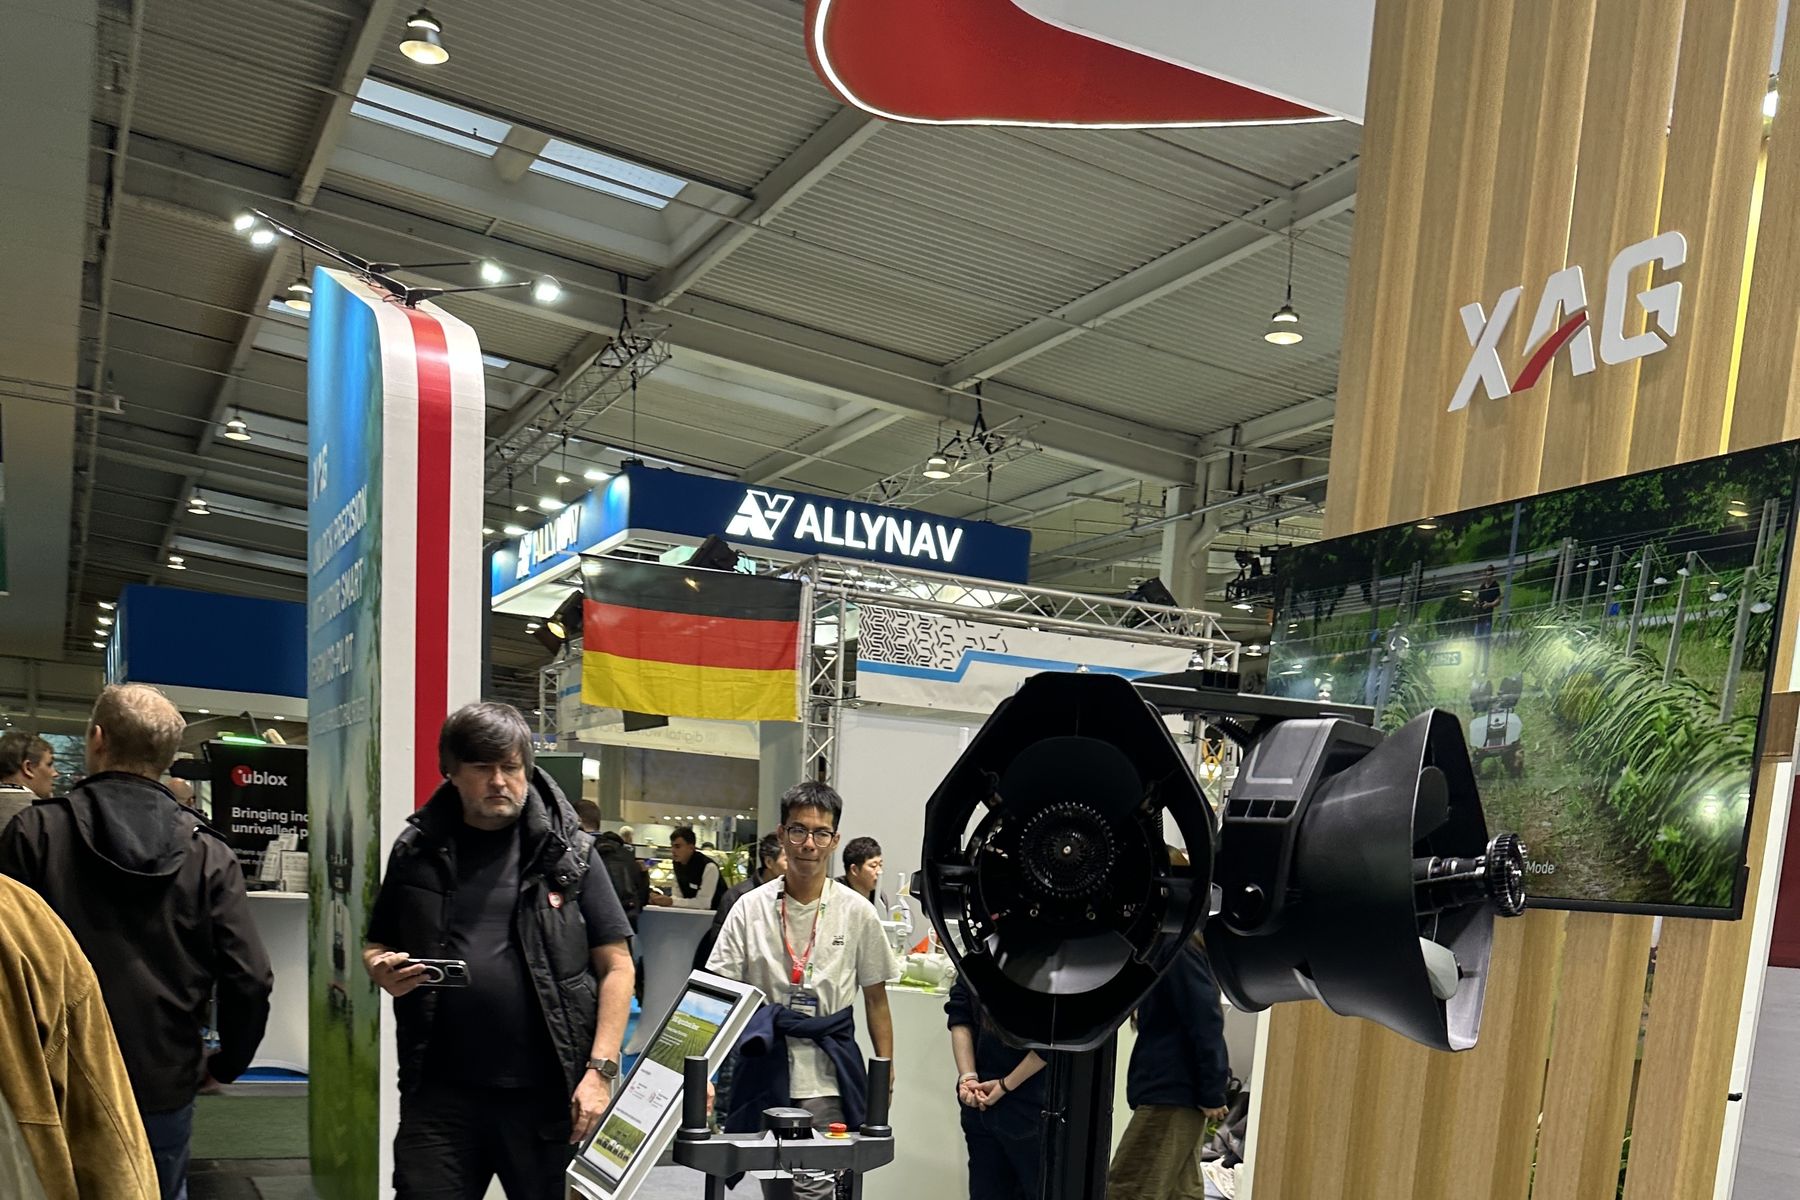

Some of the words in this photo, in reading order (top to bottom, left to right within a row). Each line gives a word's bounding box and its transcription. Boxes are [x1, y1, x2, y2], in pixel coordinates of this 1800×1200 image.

[1447, 230, 1687, 412] XAG
[532, 505, 580, 566] ALLYNAV
[794, 503, 964, 563] ALLYNAV
[232, 806, 289, 823] Bringing
[232, 823, 297, 836] unrivalled
[1526, 860, 1555, 875] Mode
